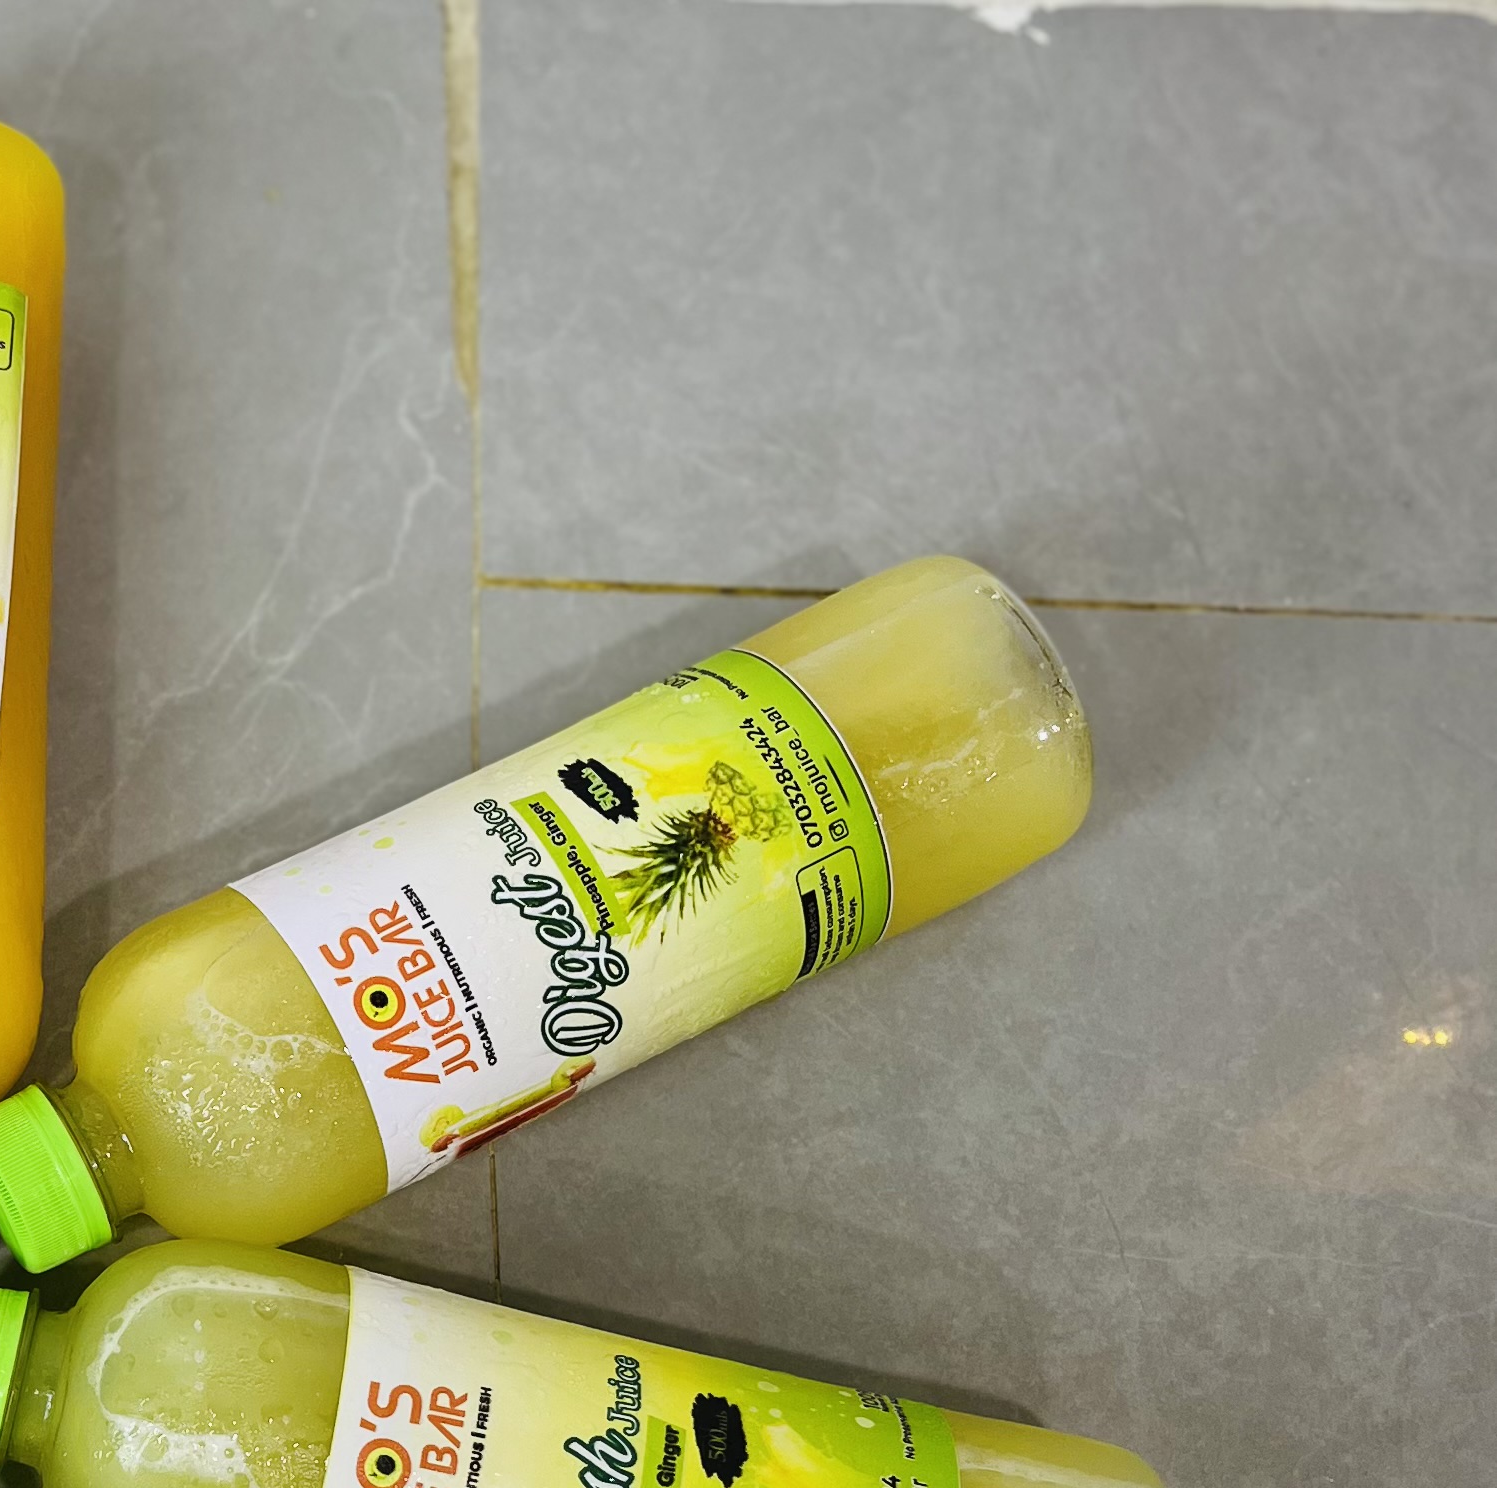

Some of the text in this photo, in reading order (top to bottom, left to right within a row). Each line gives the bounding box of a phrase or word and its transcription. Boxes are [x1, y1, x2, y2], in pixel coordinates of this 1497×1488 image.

[738, 715, 823, 847] 07032843424
[760, 704, 838, 816] mojuice_bar
[472, 799, 626, 1052] Digest Juice
[526, 799, 615, 931] Pineapple, Ginger
[317, 925, 441, 1083] MO'S
[367, 898, 479, 1075] JUICE BAR
[400, 883, 498, 1067] ORGANIC NUTRITIOUS FRESH
[419, 1386, 468, 1475] BAR
[476, 1385, 492, 1430] FRESH
[606, 1353, 640, 1436] Juice
[655, 1423, 682, 1487] Ginger
